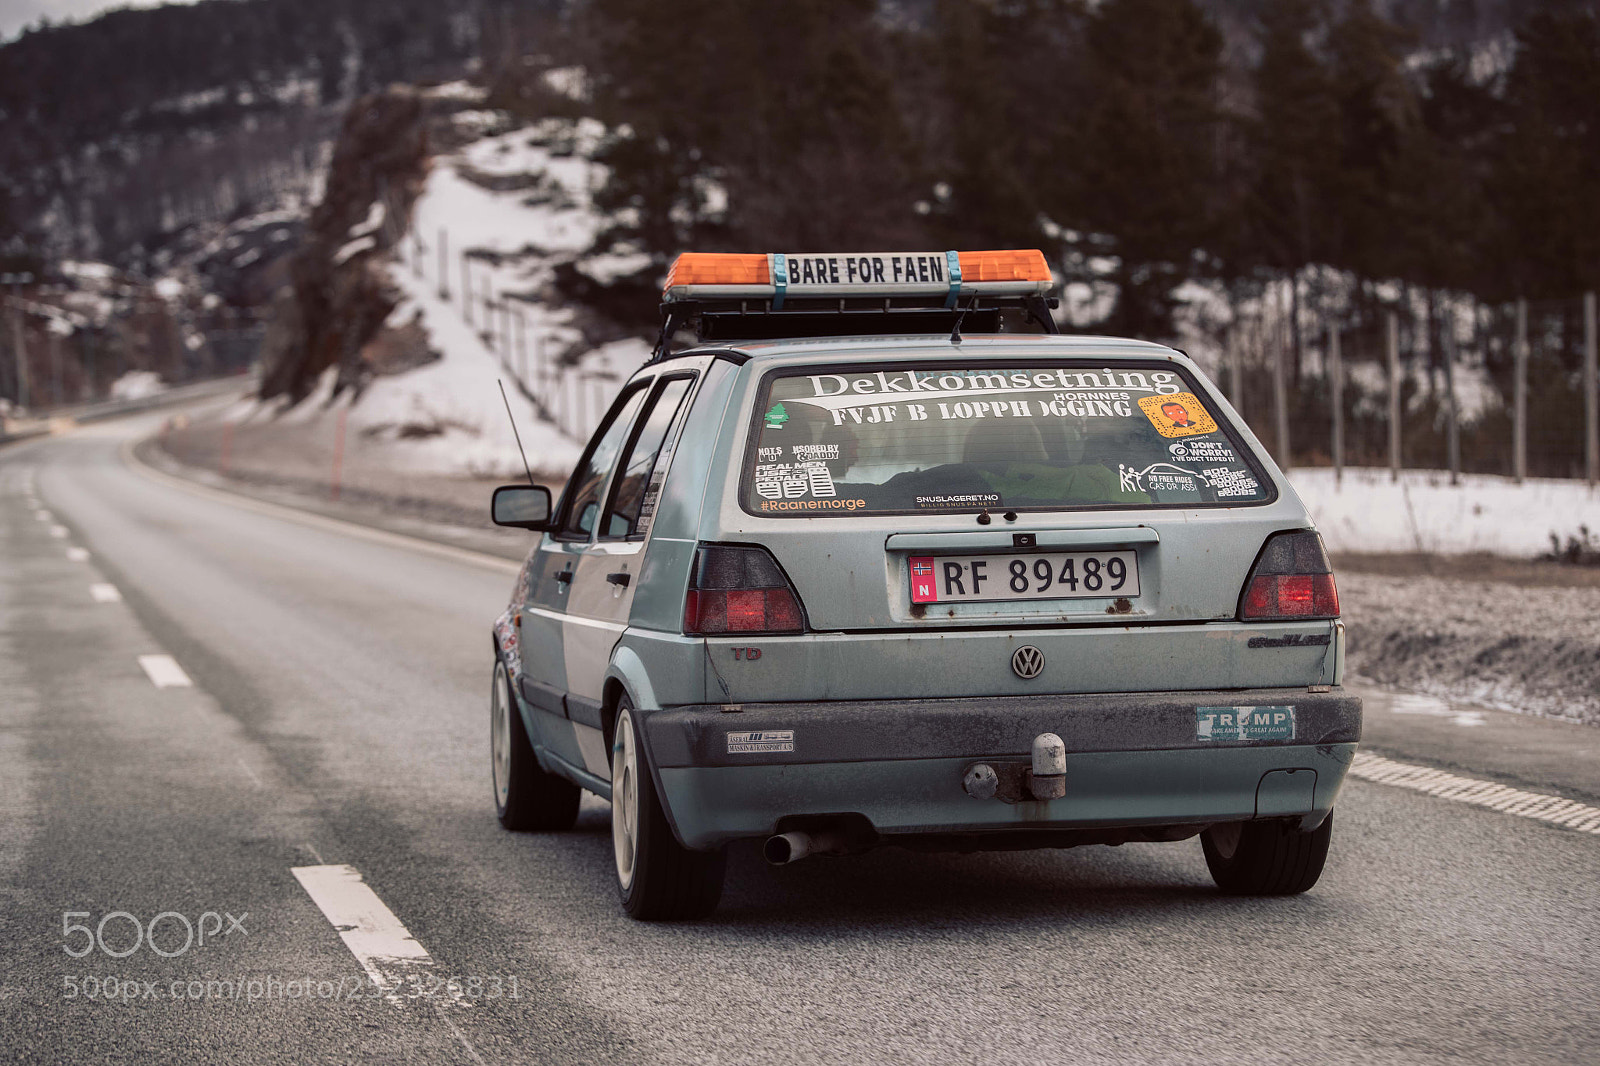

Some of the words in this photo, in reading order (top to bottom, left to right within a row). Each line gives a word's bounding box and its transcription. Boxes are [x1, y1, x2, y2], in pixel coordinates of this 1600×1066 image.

[788, 257, 840, 284] BARE
[847, 257, 886, 283] FOR
[892, 256, 943, 283] FAEN
[806, 368, 1180, 397] Dekkomsetning
[1053, 392, 1131, 401] HORNNES
[1190, 441, 1222, 449] DON'T
[756, 463, 793, 471] REAL
[794, 461, 826, 469] MEN
[1148, 475, 1158, 483] NO
[1159, 475, 1174, 483] FREE
[1174, 476, 1192, 484] RIDES
[1149, 482, 1165, 490] GAS
[1166, 482, 1178, 490] OR
[916, 494, 999, 503] SNUSLAGERET.NO
[760, 499, 866, 511] #Raanernorge
[943, 561, 988, 595] RF
[1009, 557, 1127, 593] 89489
[919, 584, 930, 596] N
[731, 647, 762, 660] TD
[1206, 713, 1286, 726] TRUMP
